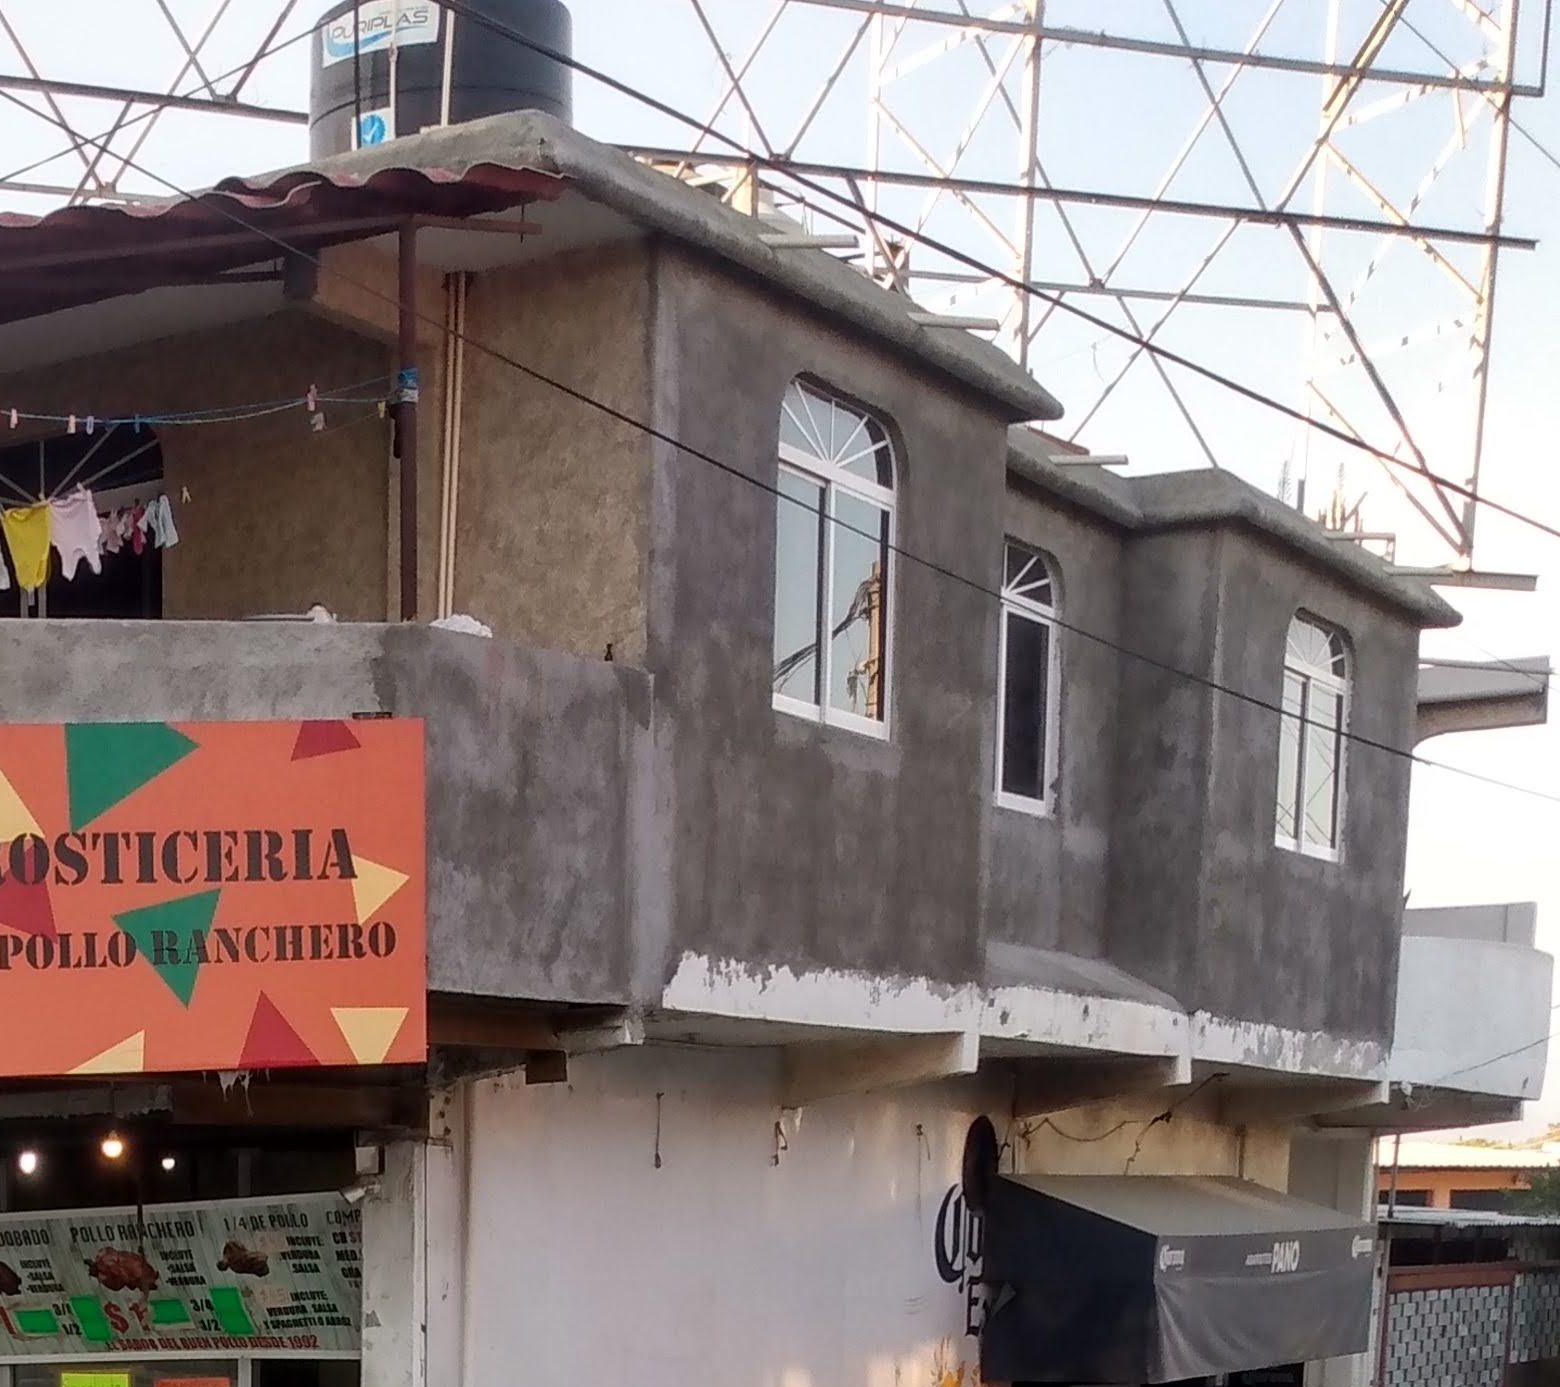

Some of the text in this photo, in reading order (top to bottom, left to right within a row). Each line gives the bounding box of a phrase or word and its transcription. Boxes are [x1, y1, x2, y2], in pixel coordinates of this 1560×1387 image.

[150, 921, 398, 966] RANCHERO
[70, 1220, 195, 1244] POLLO RANCHERO
[250, 1215, 265, 1231] DE
[269, 1212, 309, 1230] POLLO
[214, 1336, 249, 1349] POLLO
[251, 1335, 288, 1348] DESDE
[290, 1335, 320, 1349] 1992
